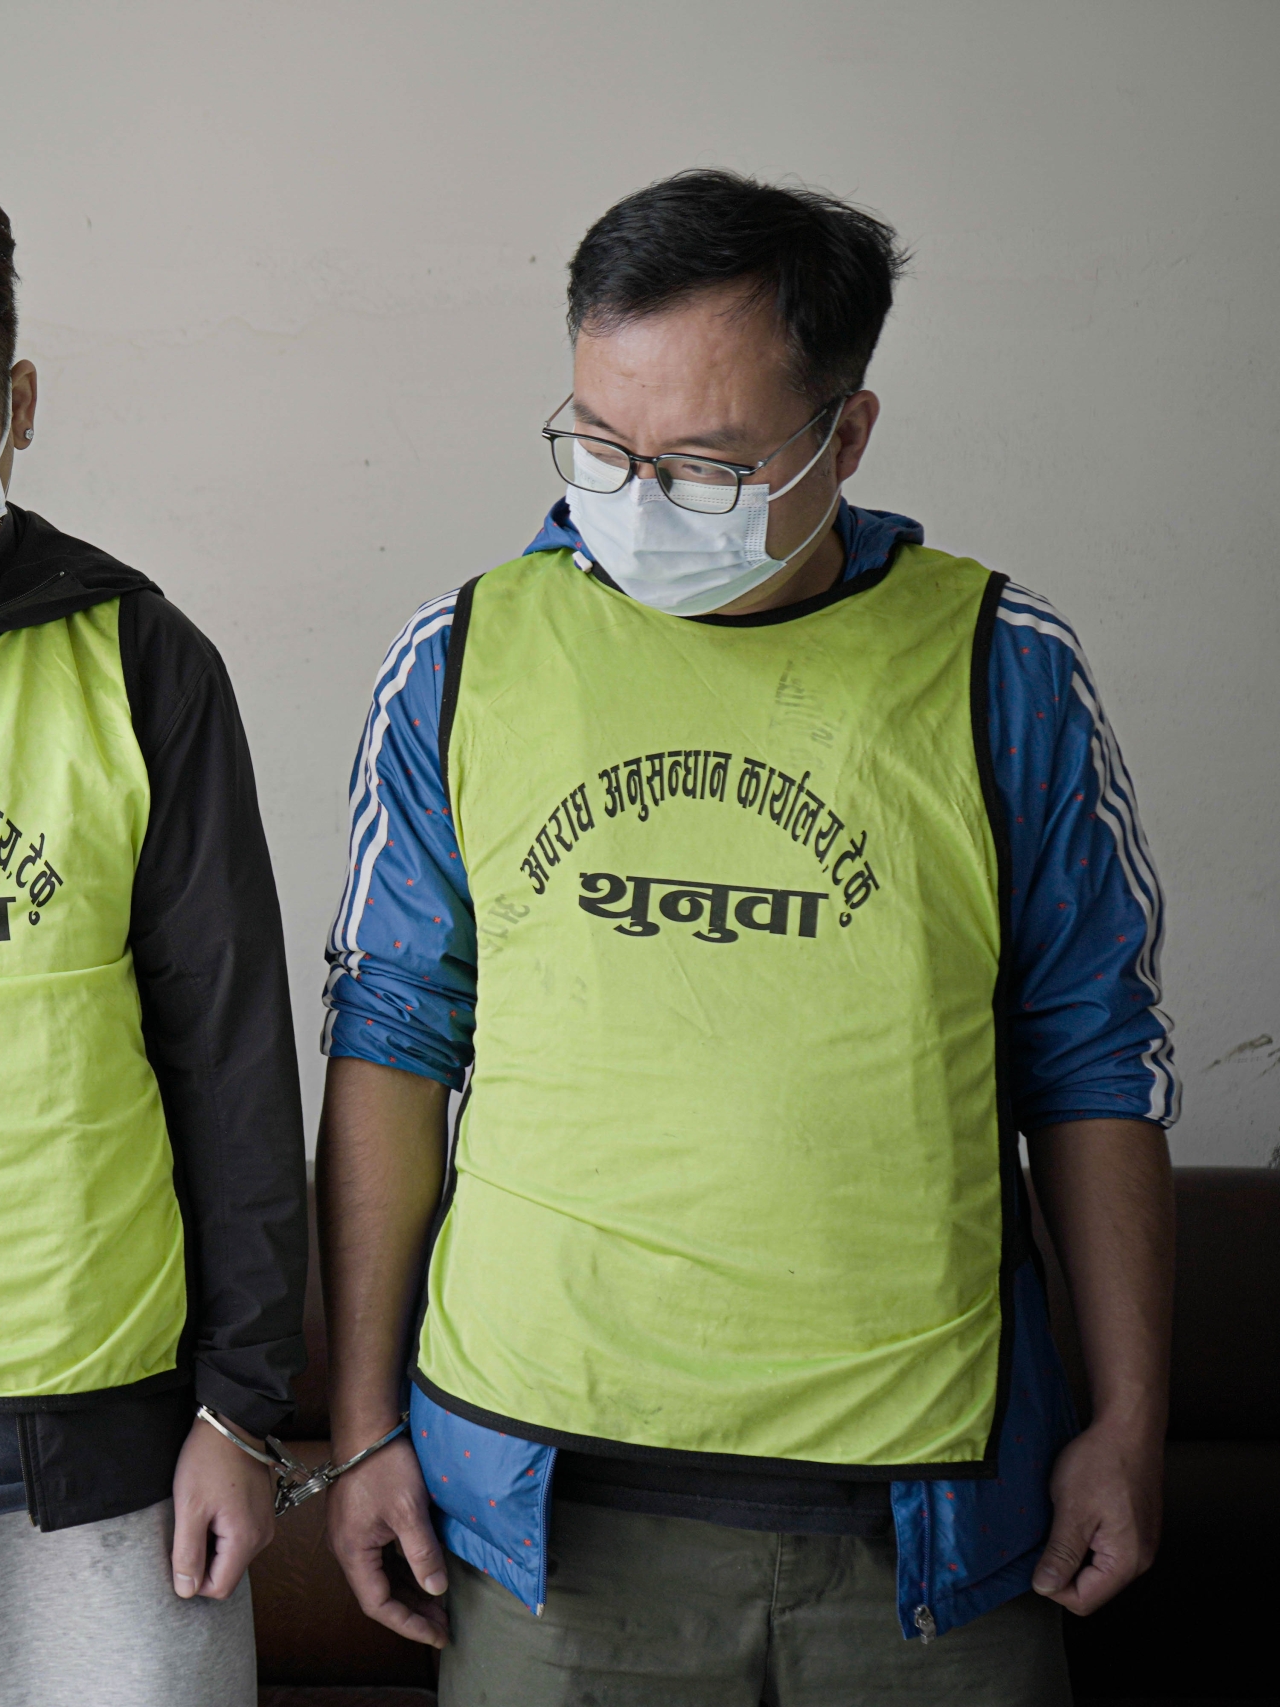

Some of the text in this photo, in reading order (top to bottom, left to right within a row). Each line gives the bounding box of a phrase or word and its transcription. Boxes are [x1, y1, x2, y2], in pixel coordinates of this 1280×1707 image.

[519, 782, 596, 895] अपराध
[598, 749, 733, 823] अनुसन्धान
[578, 872, 830, 944] थुनुवा
